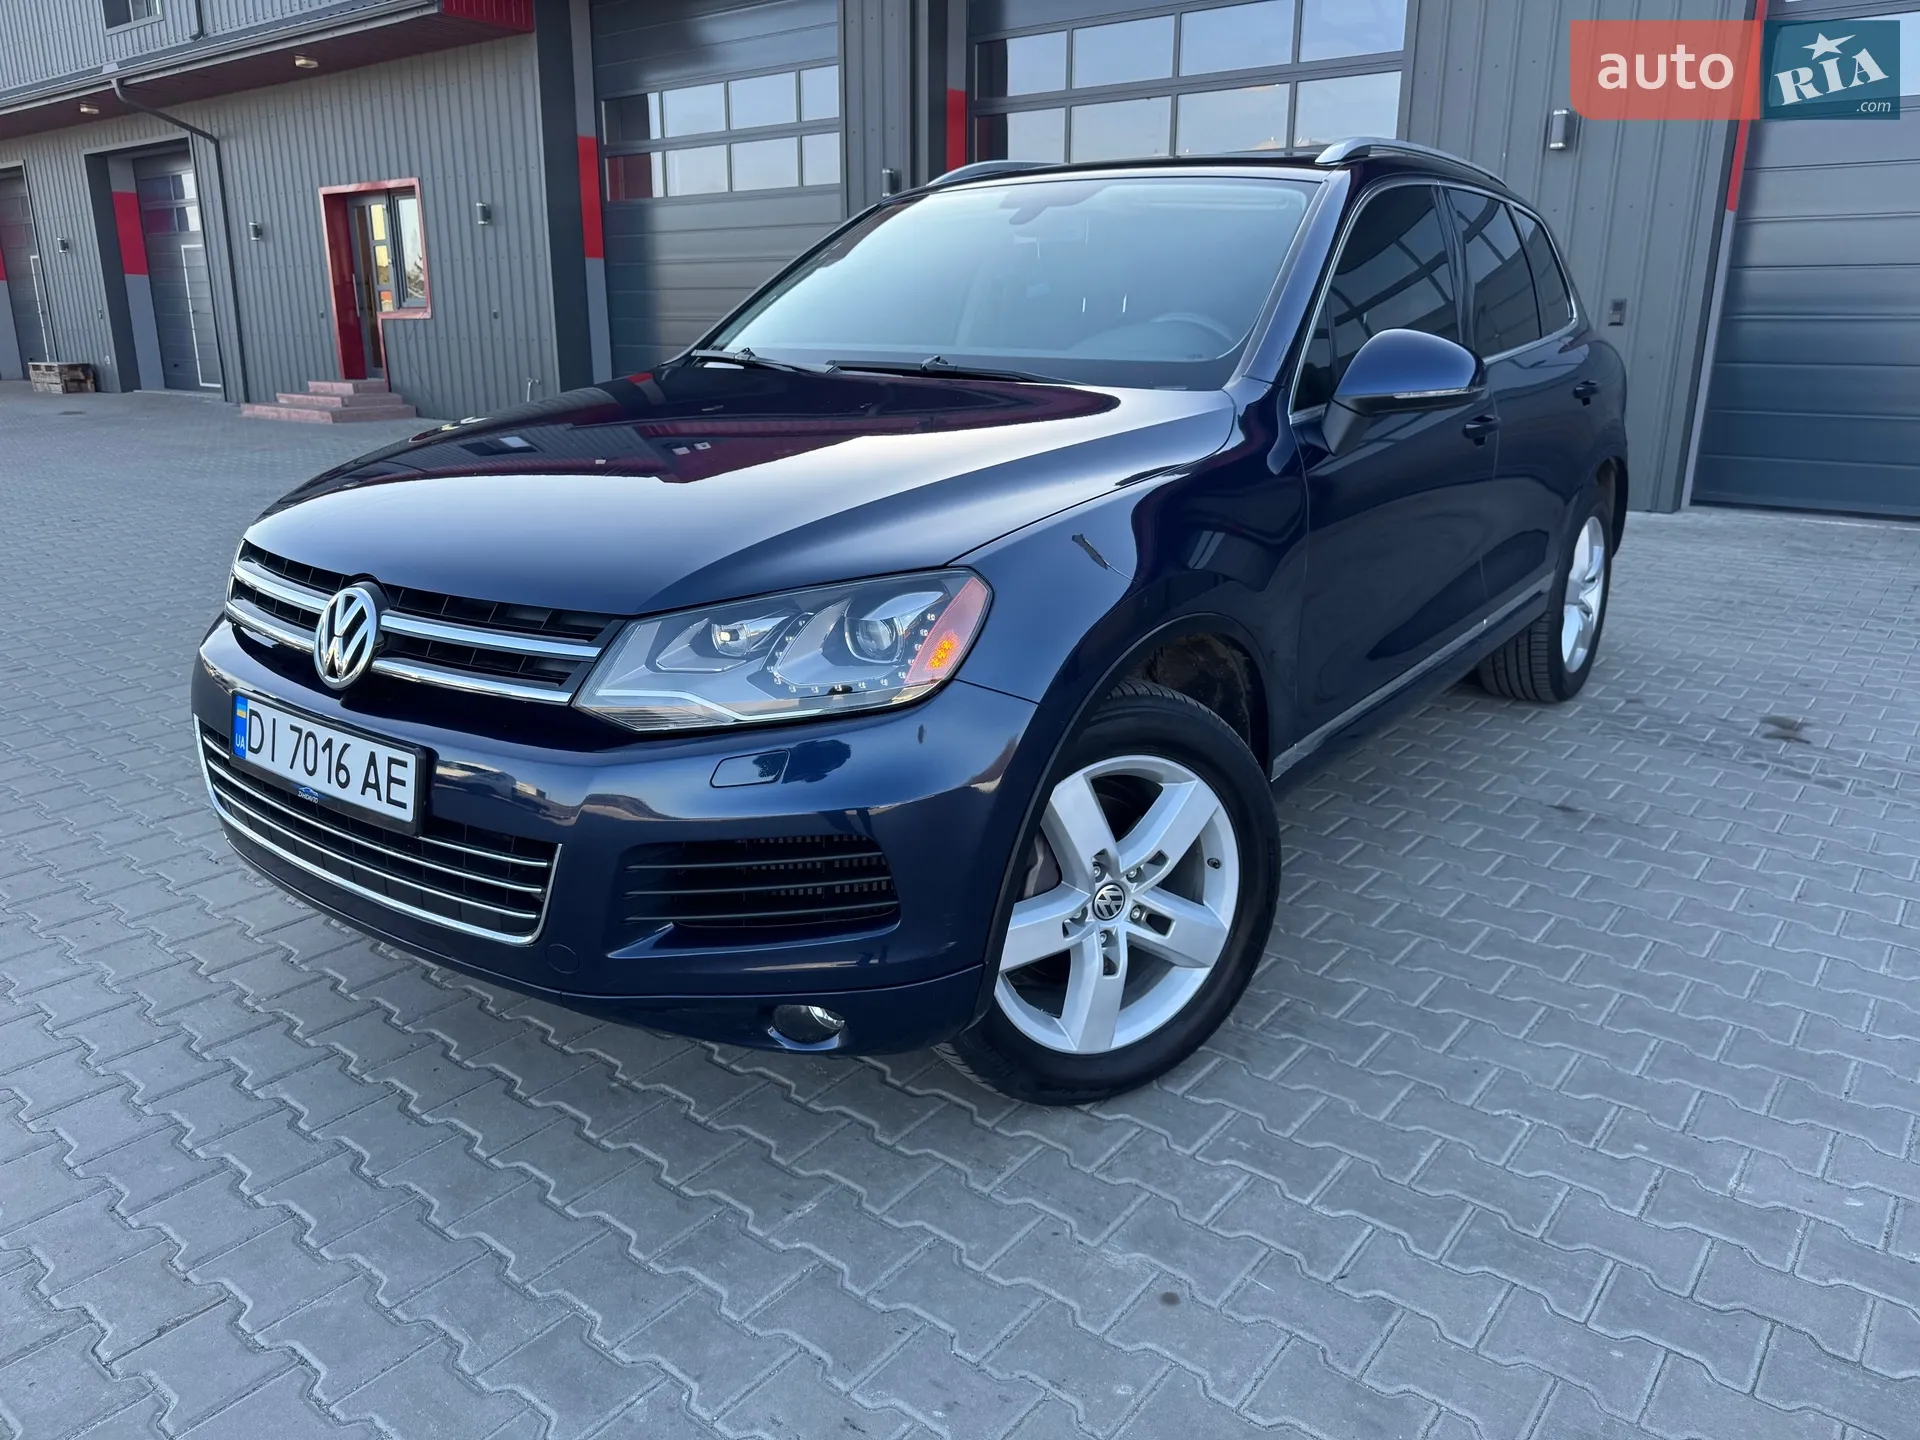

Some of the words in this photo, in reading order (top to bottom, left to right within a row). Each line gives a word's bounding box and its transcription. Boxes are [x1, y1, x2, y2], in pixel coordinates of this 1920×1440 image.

[235, 733, 246, 750] UA
[247, 708, 276, 762] DI
[289, 724, 351, 789] 7016
[360, 751, 408, 810] AE
